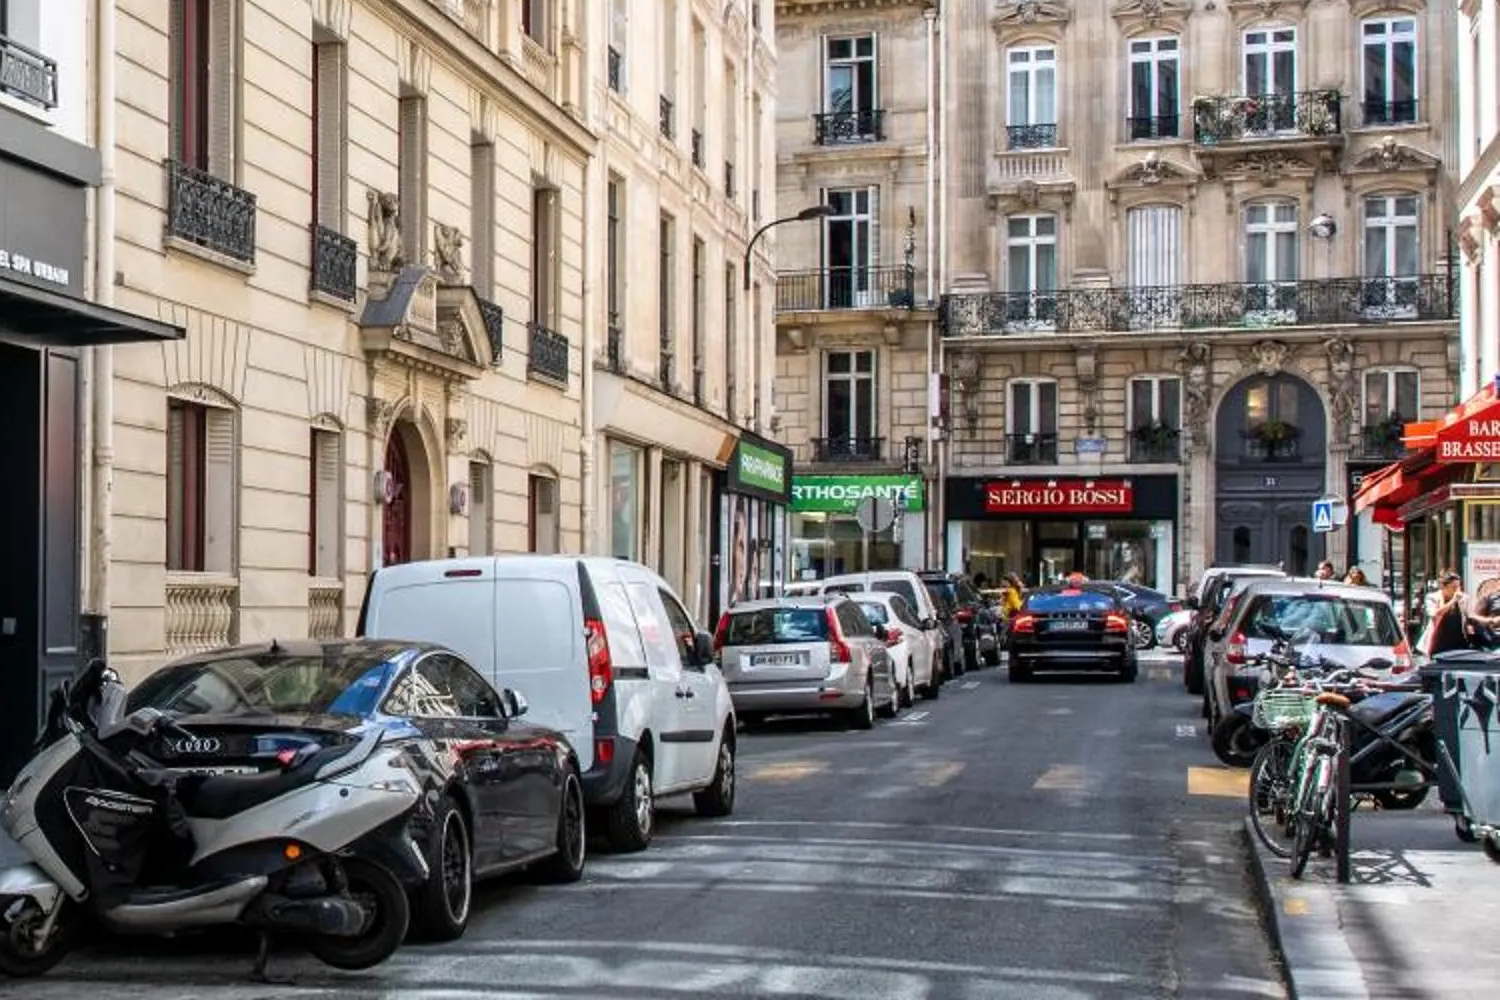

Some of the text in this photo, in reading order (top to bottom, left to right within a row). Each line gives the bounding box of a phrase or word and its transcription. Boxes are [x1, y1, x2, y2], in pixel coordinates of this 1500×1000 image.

[11, 253, 32, 275] SPA
[1469, 419, 1500, 437] BAR
[792, 479, 918, 500] RTHOSANTÉ
[989, 488, 1127, 506] SERGIO BOSSI
